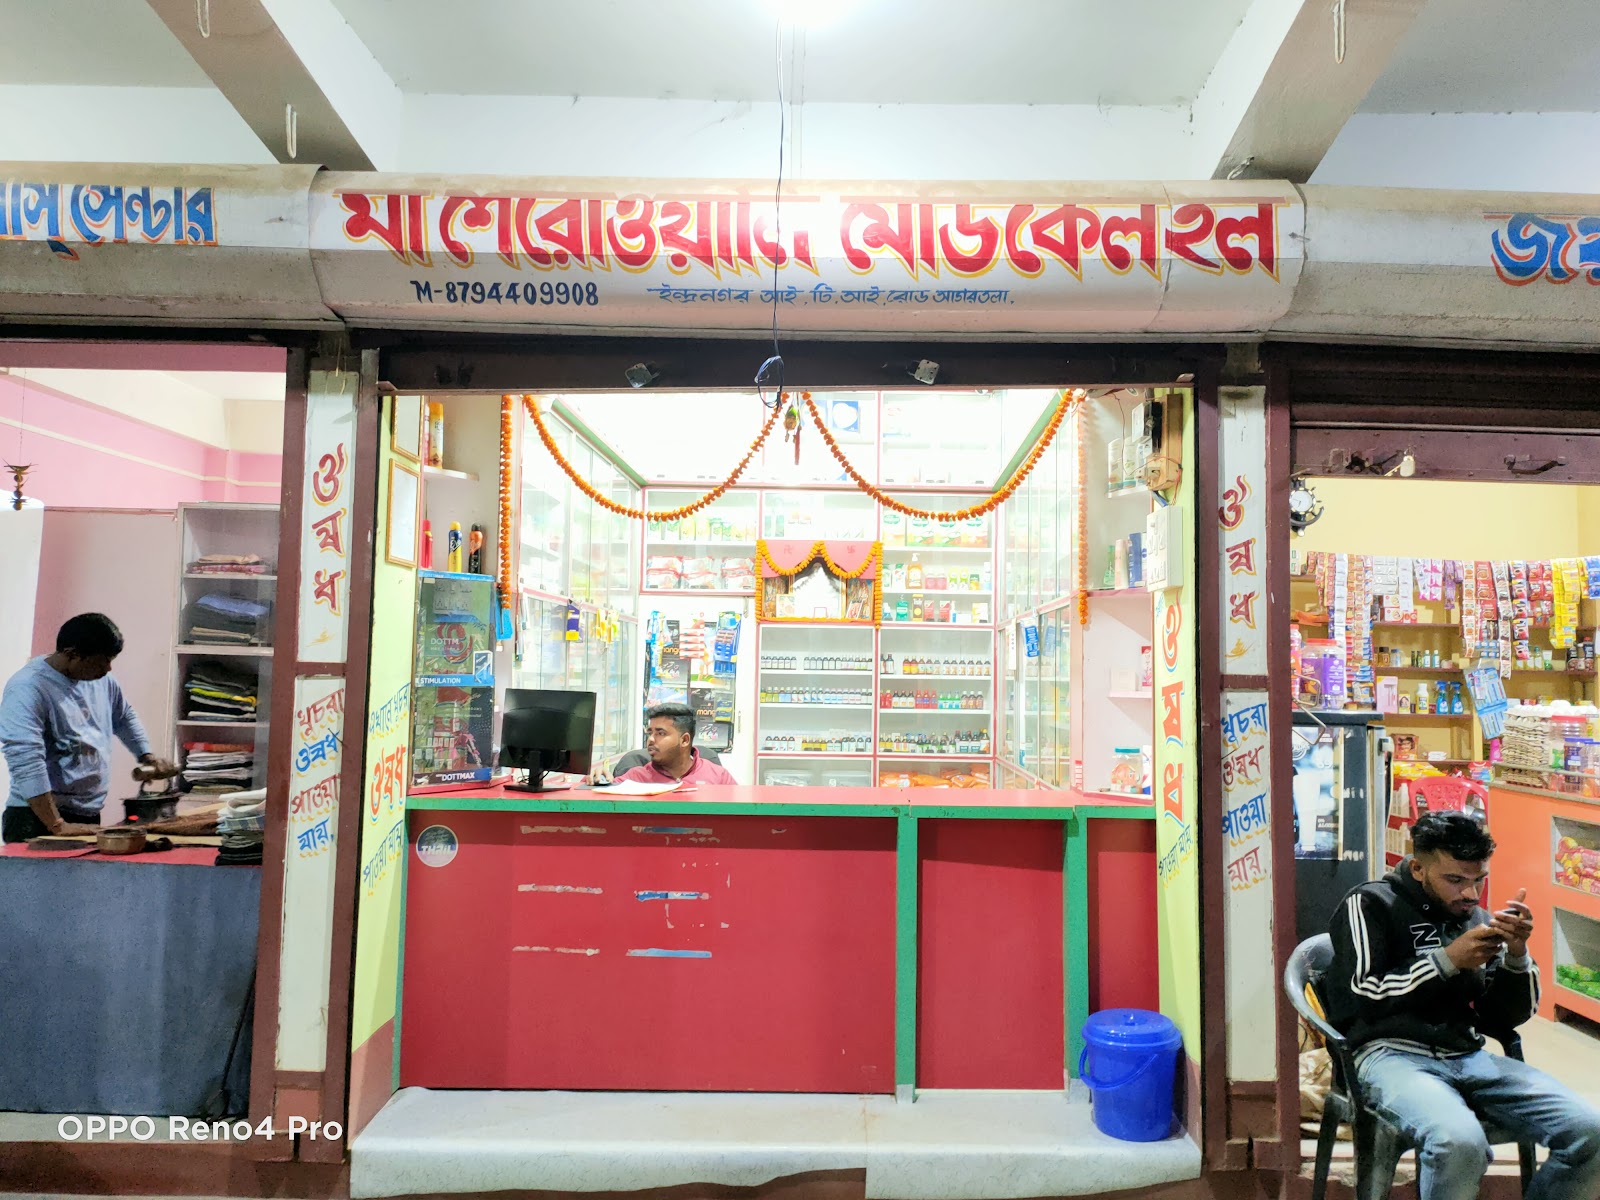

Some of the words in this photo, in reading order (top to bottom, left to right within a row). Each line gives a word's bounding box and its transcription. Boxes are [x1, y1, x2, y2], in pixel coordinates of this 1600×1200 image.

[334, 189, 433, 267] মা
[1164, 196, 1286, 283] হল
[410, 280, 599, 306] M-8794409908
[441, 772, 475, 781] DOTTMAX
